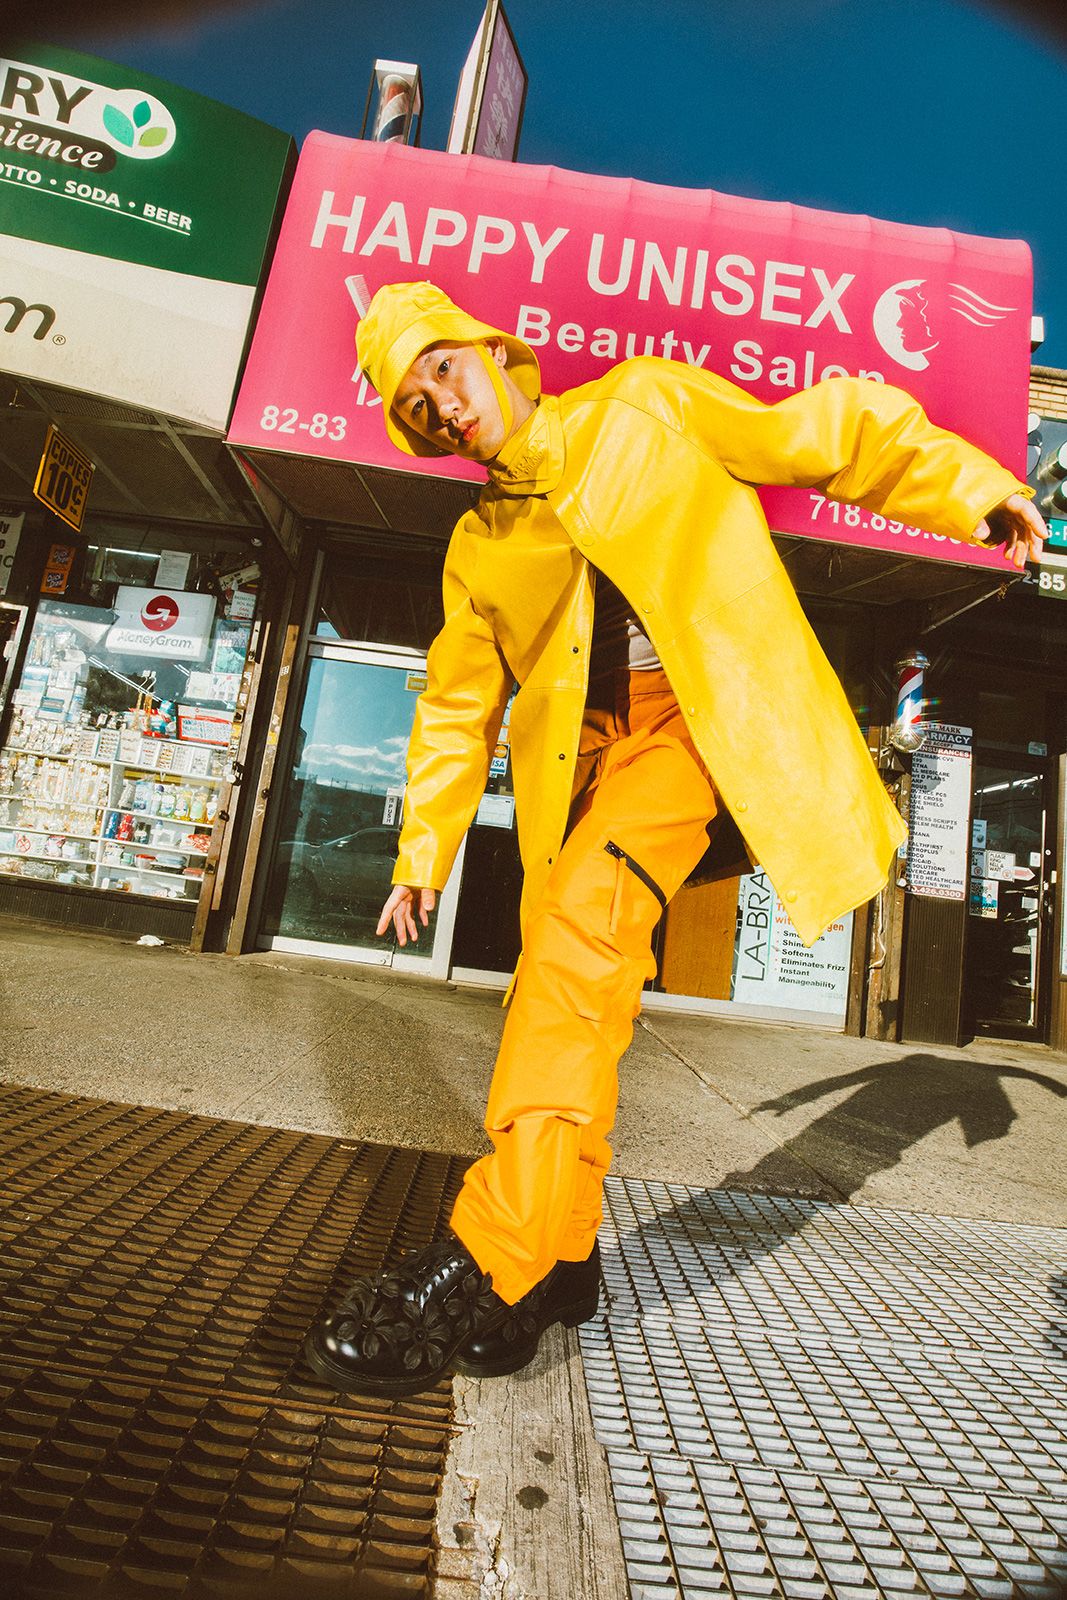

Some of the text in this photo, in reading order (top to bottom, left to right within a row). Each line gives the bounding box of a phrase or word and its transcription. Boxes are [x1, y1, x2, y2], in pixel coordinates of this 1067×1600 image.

[0, 121, 104, 168] ience
[0, 162, 193, 230] TTO SODA BEER
[309, 190, 856, 335] HAPPY UNISEX
[259, 405, 348, 442] 82-83
[51, 440, 89, 487] COPIES
[116, 630, 192, 649] MoneyGram
[920, 769, 951, 777] MEDICARE
[912, 863, 946, 872] SOLUTIONS
[925, 876, 964, 885] HEALTHCARE
[781, 949, 814, 959] Softens
[780, 968, 810, 976] Instant
[781, 958, 846, 972] Eliminates Frizz
[778, 976, 837, 990] Manageability
